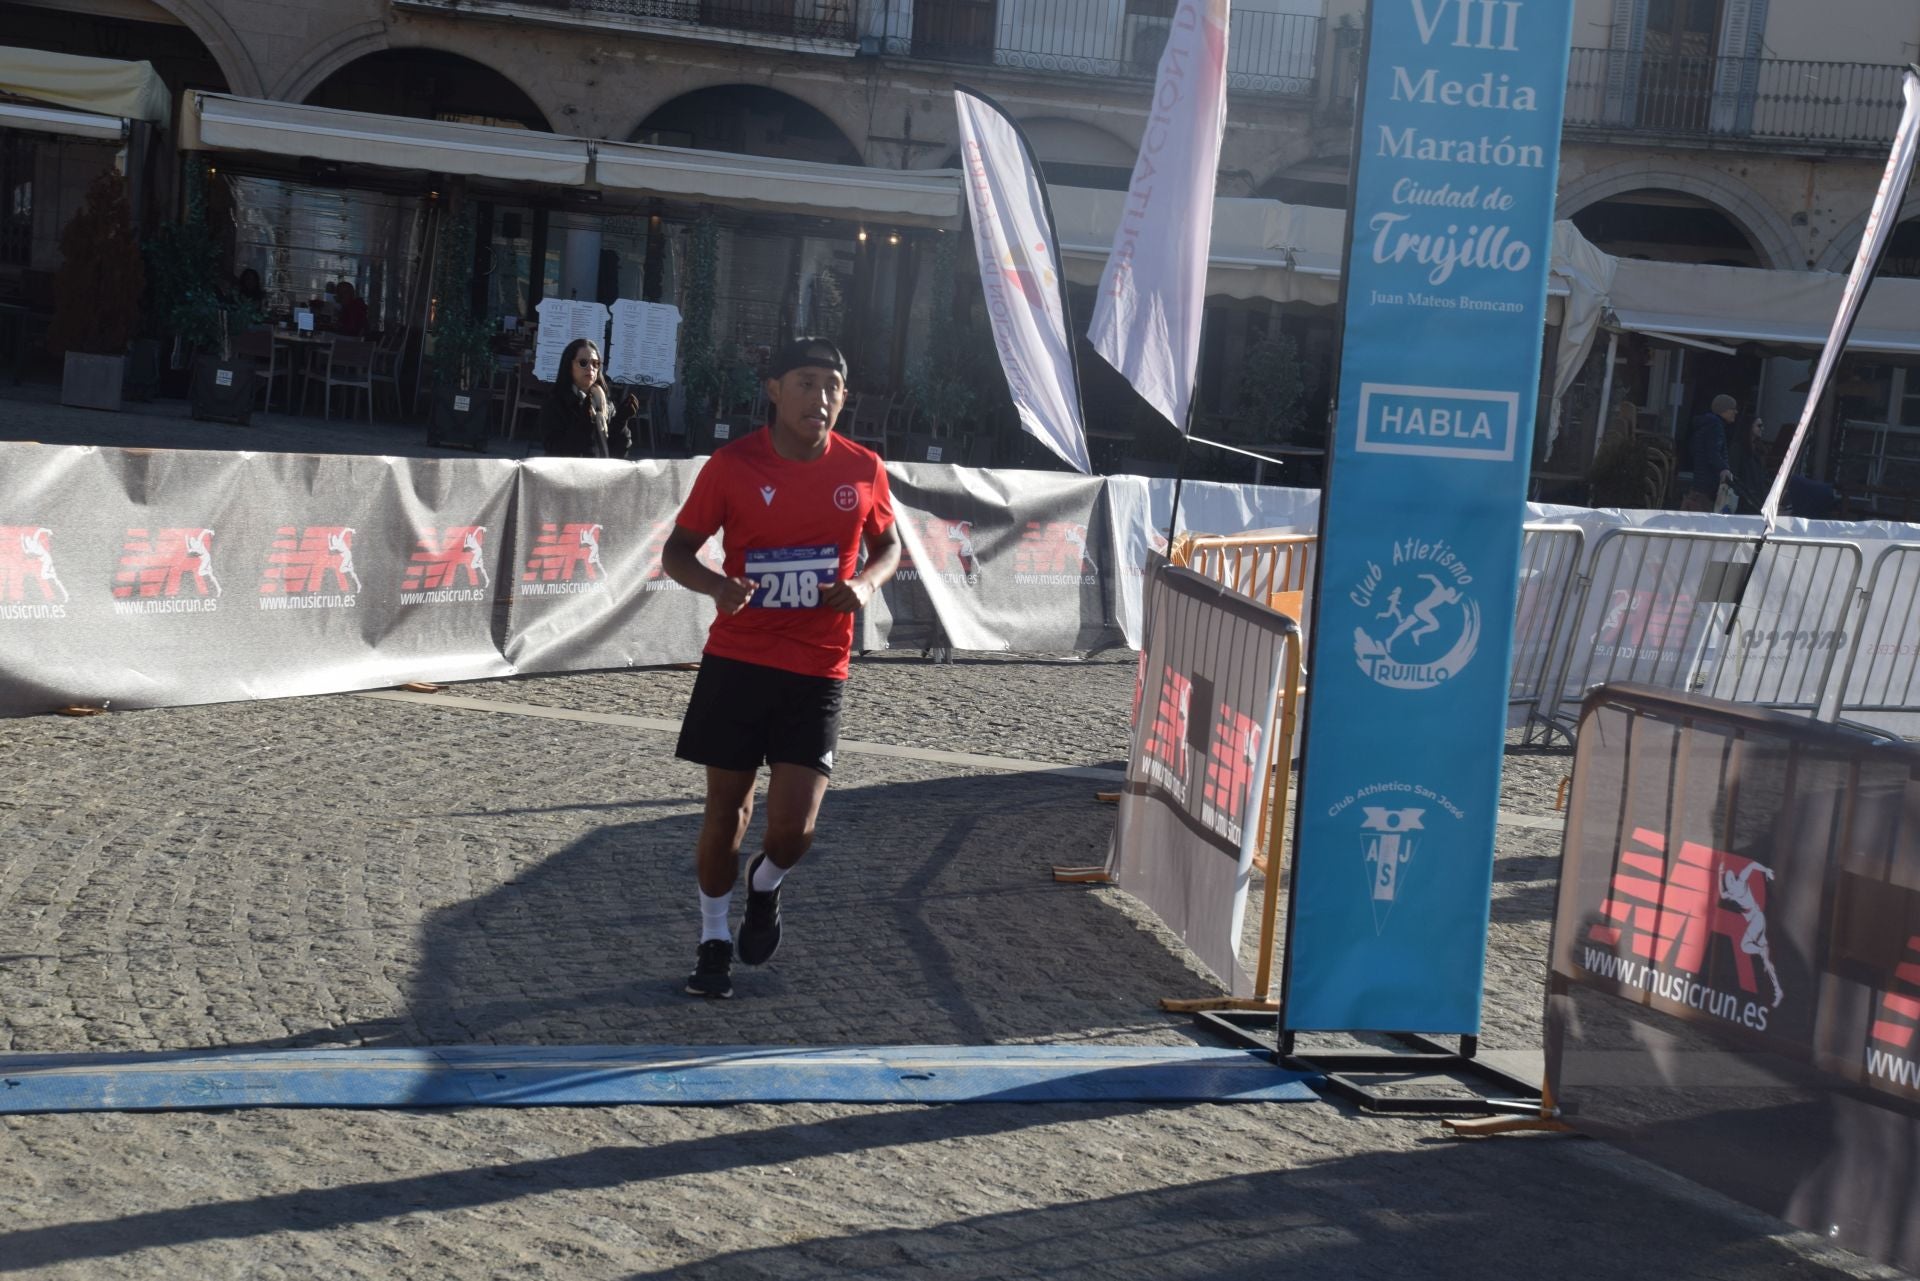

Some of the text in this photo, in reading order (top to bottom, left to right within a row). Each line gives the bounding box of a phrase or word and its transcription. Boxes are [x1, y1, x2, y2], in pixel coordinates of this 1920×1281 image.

[1410, 0, 1523, 51] VIII
[1390, 66, 1538, 111] Media
[1376, 125, 1544, 168] Maratón
[1392, 177, 1517, 211] Ciudad de
[1369, 212, 1531, 286] Trujillo
[1370, 290, 1524, 313] Juan Mateos Broncano
[1380, 405, 1493, 440] HABLA
[521, 579, 606, 595] www.musicrun.es
[1014, 573, 1096, 585] www.musicrun.es
[1350, 537, 1473, 607] Club Atletismo
[114, 597, 217, 615] www.musicrun.es
[259, 592, 355, 611] www.musicrun.es
[400, 587, 484, 605] www.musicrun.es
[761, 571, 819, 608] 248
[1363, 654, 1449, 682] TRUJILLO
[1328, 781, 1465, 819] Club Athletico San José
[1366, 839, 1411, 863] A J
[1380, 863, 1392, 886] S
[1584, 947, 1769, 1031] www.musicrun.es
